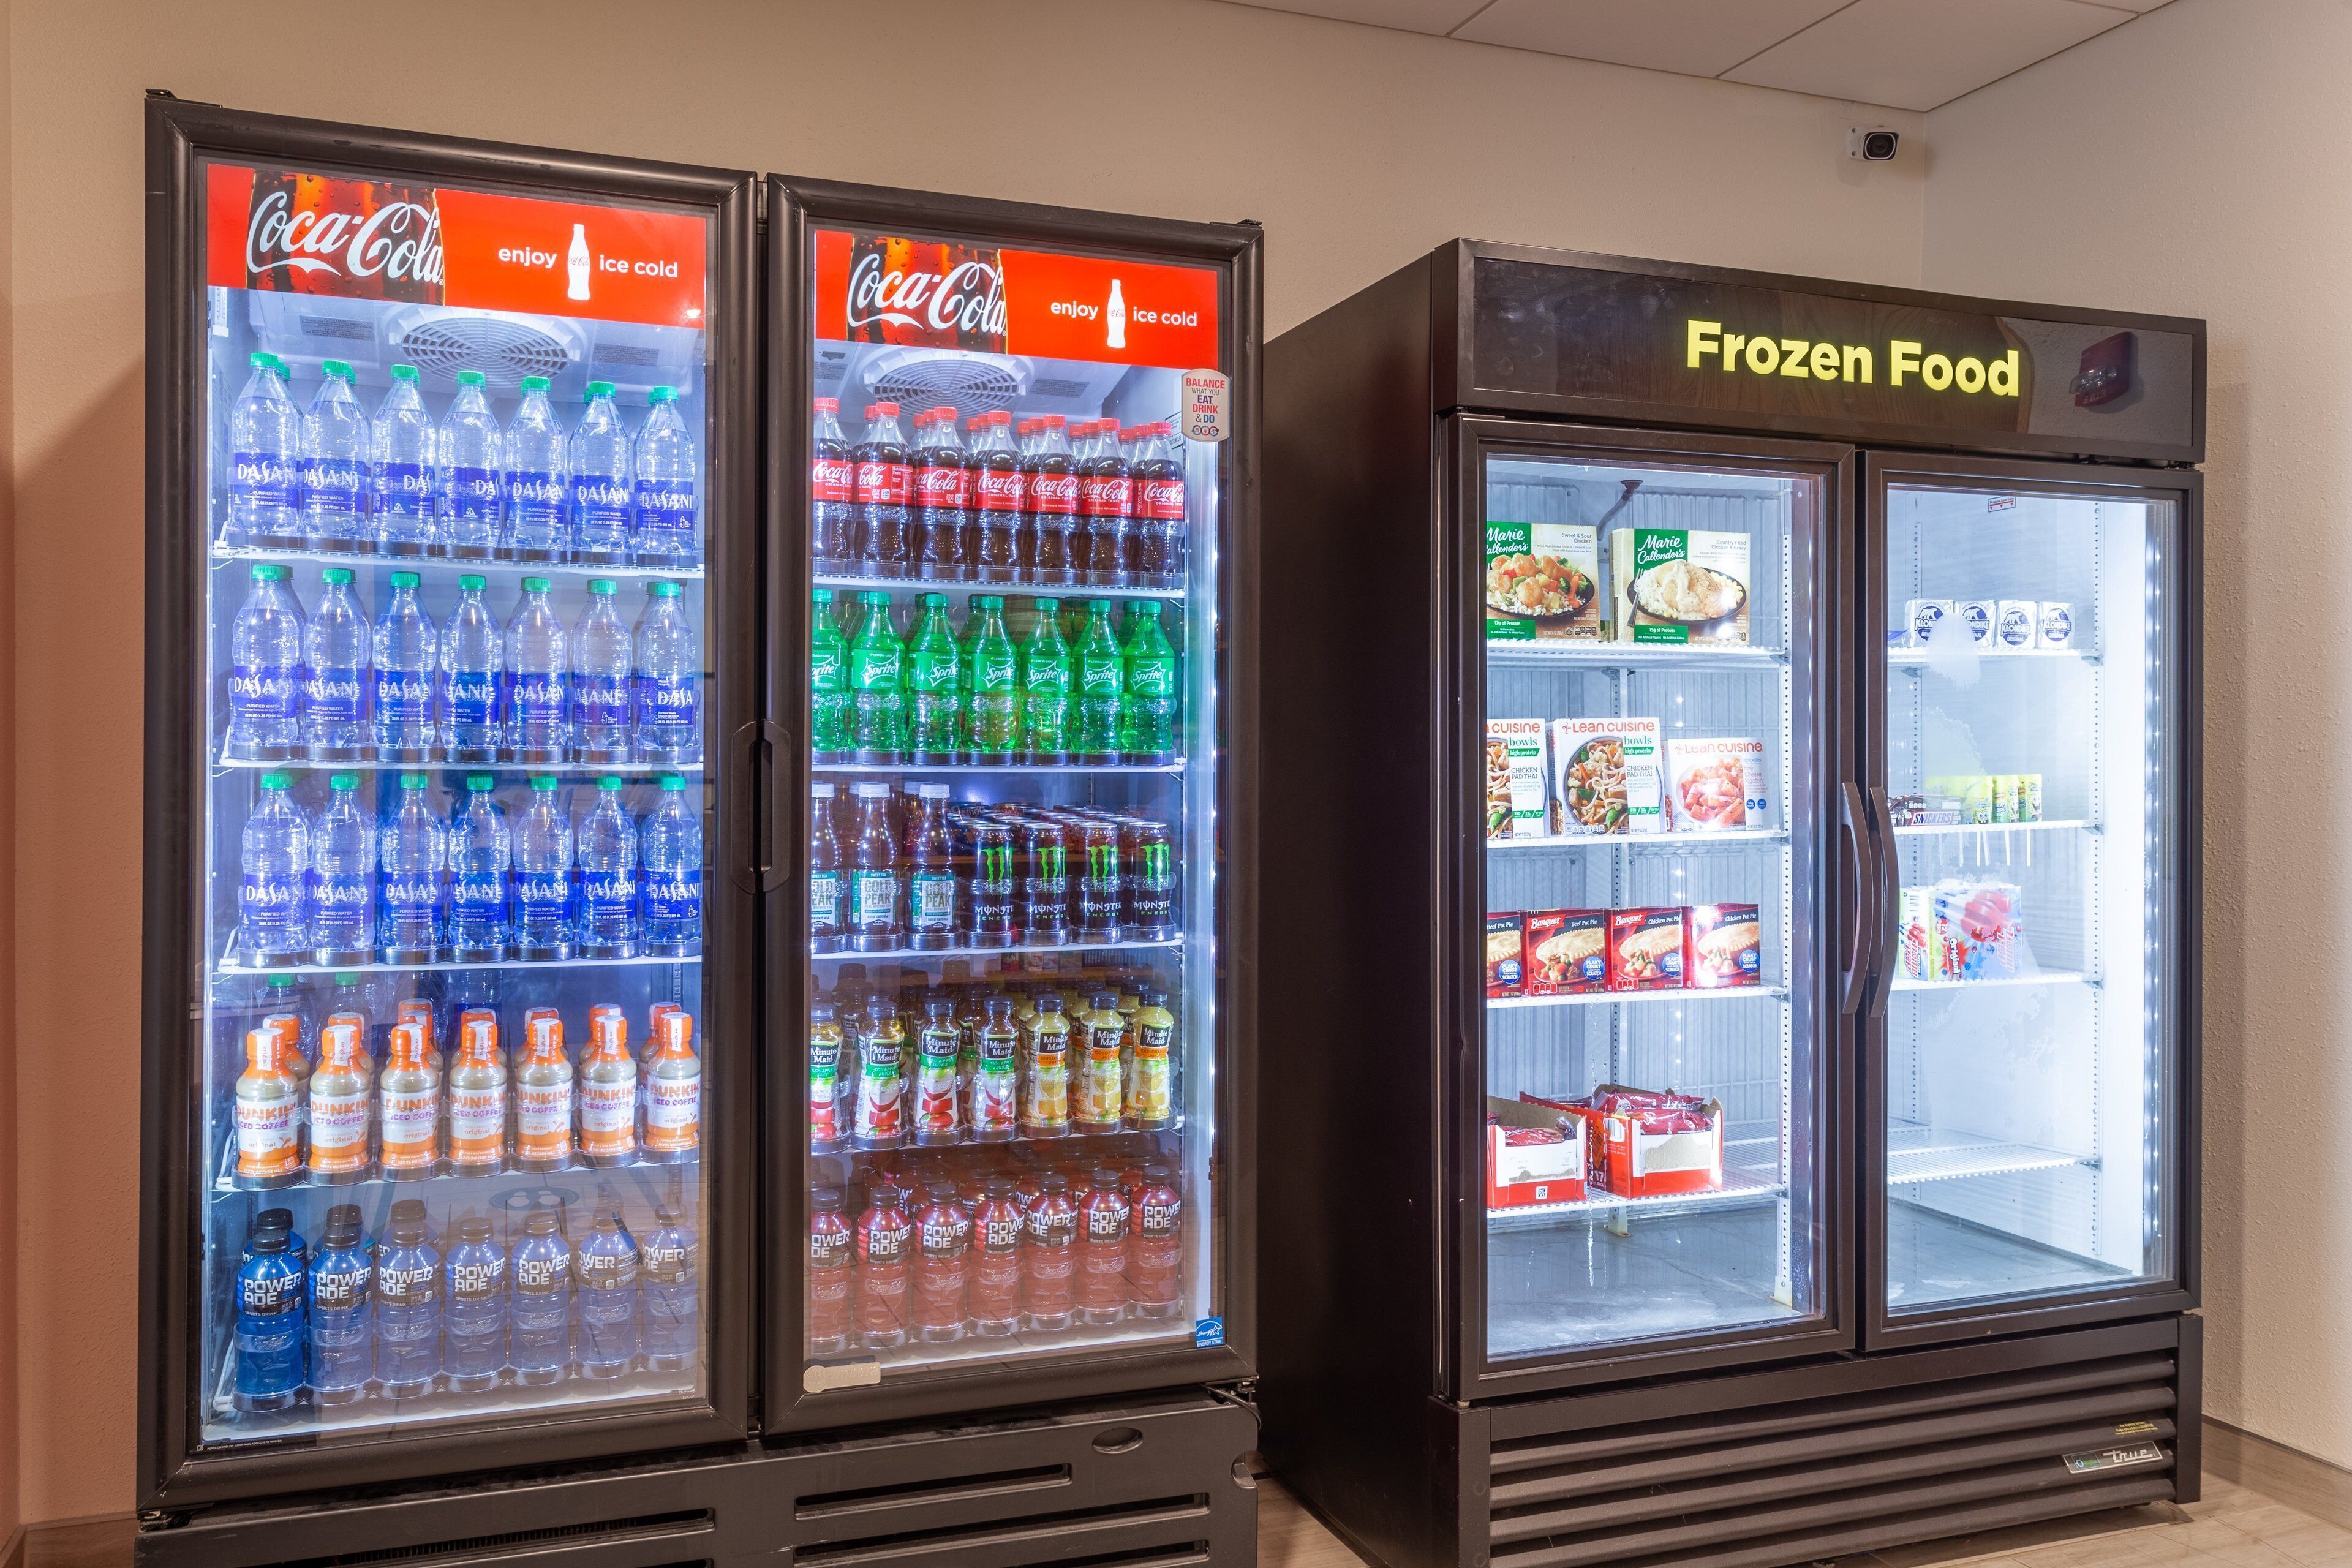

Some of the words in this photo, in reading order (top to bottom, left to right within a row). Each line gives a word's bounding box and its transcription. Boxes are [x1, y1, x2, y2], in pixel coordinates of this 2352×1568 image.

[247, 191, 443, 284] Coca-Cola
[499, 247, 557, 268] enjoy
[600, 255, 629, 273] ice
[634, 260, 678, 278] cold
[846, 254, 1006, 335] Coca-Cola
[1051, 300, 1099, 320] enjoy
[1133, 306, 1157, 323] ice
[1161, 311, 1197, 326] cold
[1687, 319, 1872, 385] Frozen
[1890, 339, 2019, 397] Food
[1186, 378, 1225, 388] BALANCE
[1192, 404, 1218, 414] DRINK
[1196, 414, 1202, 423] &
[1204, 414, 1215, 423] DO
[578, 483, 630, 505] DASANI
[1082, 479, 1131, 500] Coca-Cola
[642, 490, 692, 511] DASANI
[1486, 527, 1525, 543] Marie
[1638, 535, 1682, 551] Marie
[1637, 549, 1684, 564] Callender's
[866, 664, 896, 676] Sprite
[1029, 668, 1057, 681] Sprite
[1084, 669, 1114, 682] Sprite
[1134, 669, 1163, 682] Sprite
[1509, 737, 1537, 746] bowls
[1624, 736, 1652, 745] bowls
[1913, 812, 1951, 824] SNICKERS
[865, 892, 892, 905] PEAK
[1531, 916, 1561, 930] Banquet
[1615, 914, 1643, 926] Banquet
[1949, 938, 1961, 975] Original
[1144, 1028, 1167, 1036] Minute
[873, 1046, 900, 1054] Minute
[989, 1040, 1016, 1049] Minute
[814, 1055, 833, 1063] Maid
[877, 1054, 898, 1062] Maid
[654, 1098, 670, 1106] ICED
[673, 1096, 696, 1106] COFFEE
[1027, 1209, 1071, 1226] POWER
[924, 1221, 968, 1238] POWER
[1090, 1223, 1117, 1234] ADE
[924, 1236, 951, 1248] ADE
[519, 1253, 570, 1273] POWER
[245, 1272, 301, 1293] POWER
[317, 1267, 372, 1287] POWER
[380, 1267, 434, 1284] POWER
[519, 1272, 550, 1286] ADE
[316, 1286, 349, 1300] ADE
[380, 1280, 407, 1296] ADE
[244, 1292, 278, 1305] ADE
